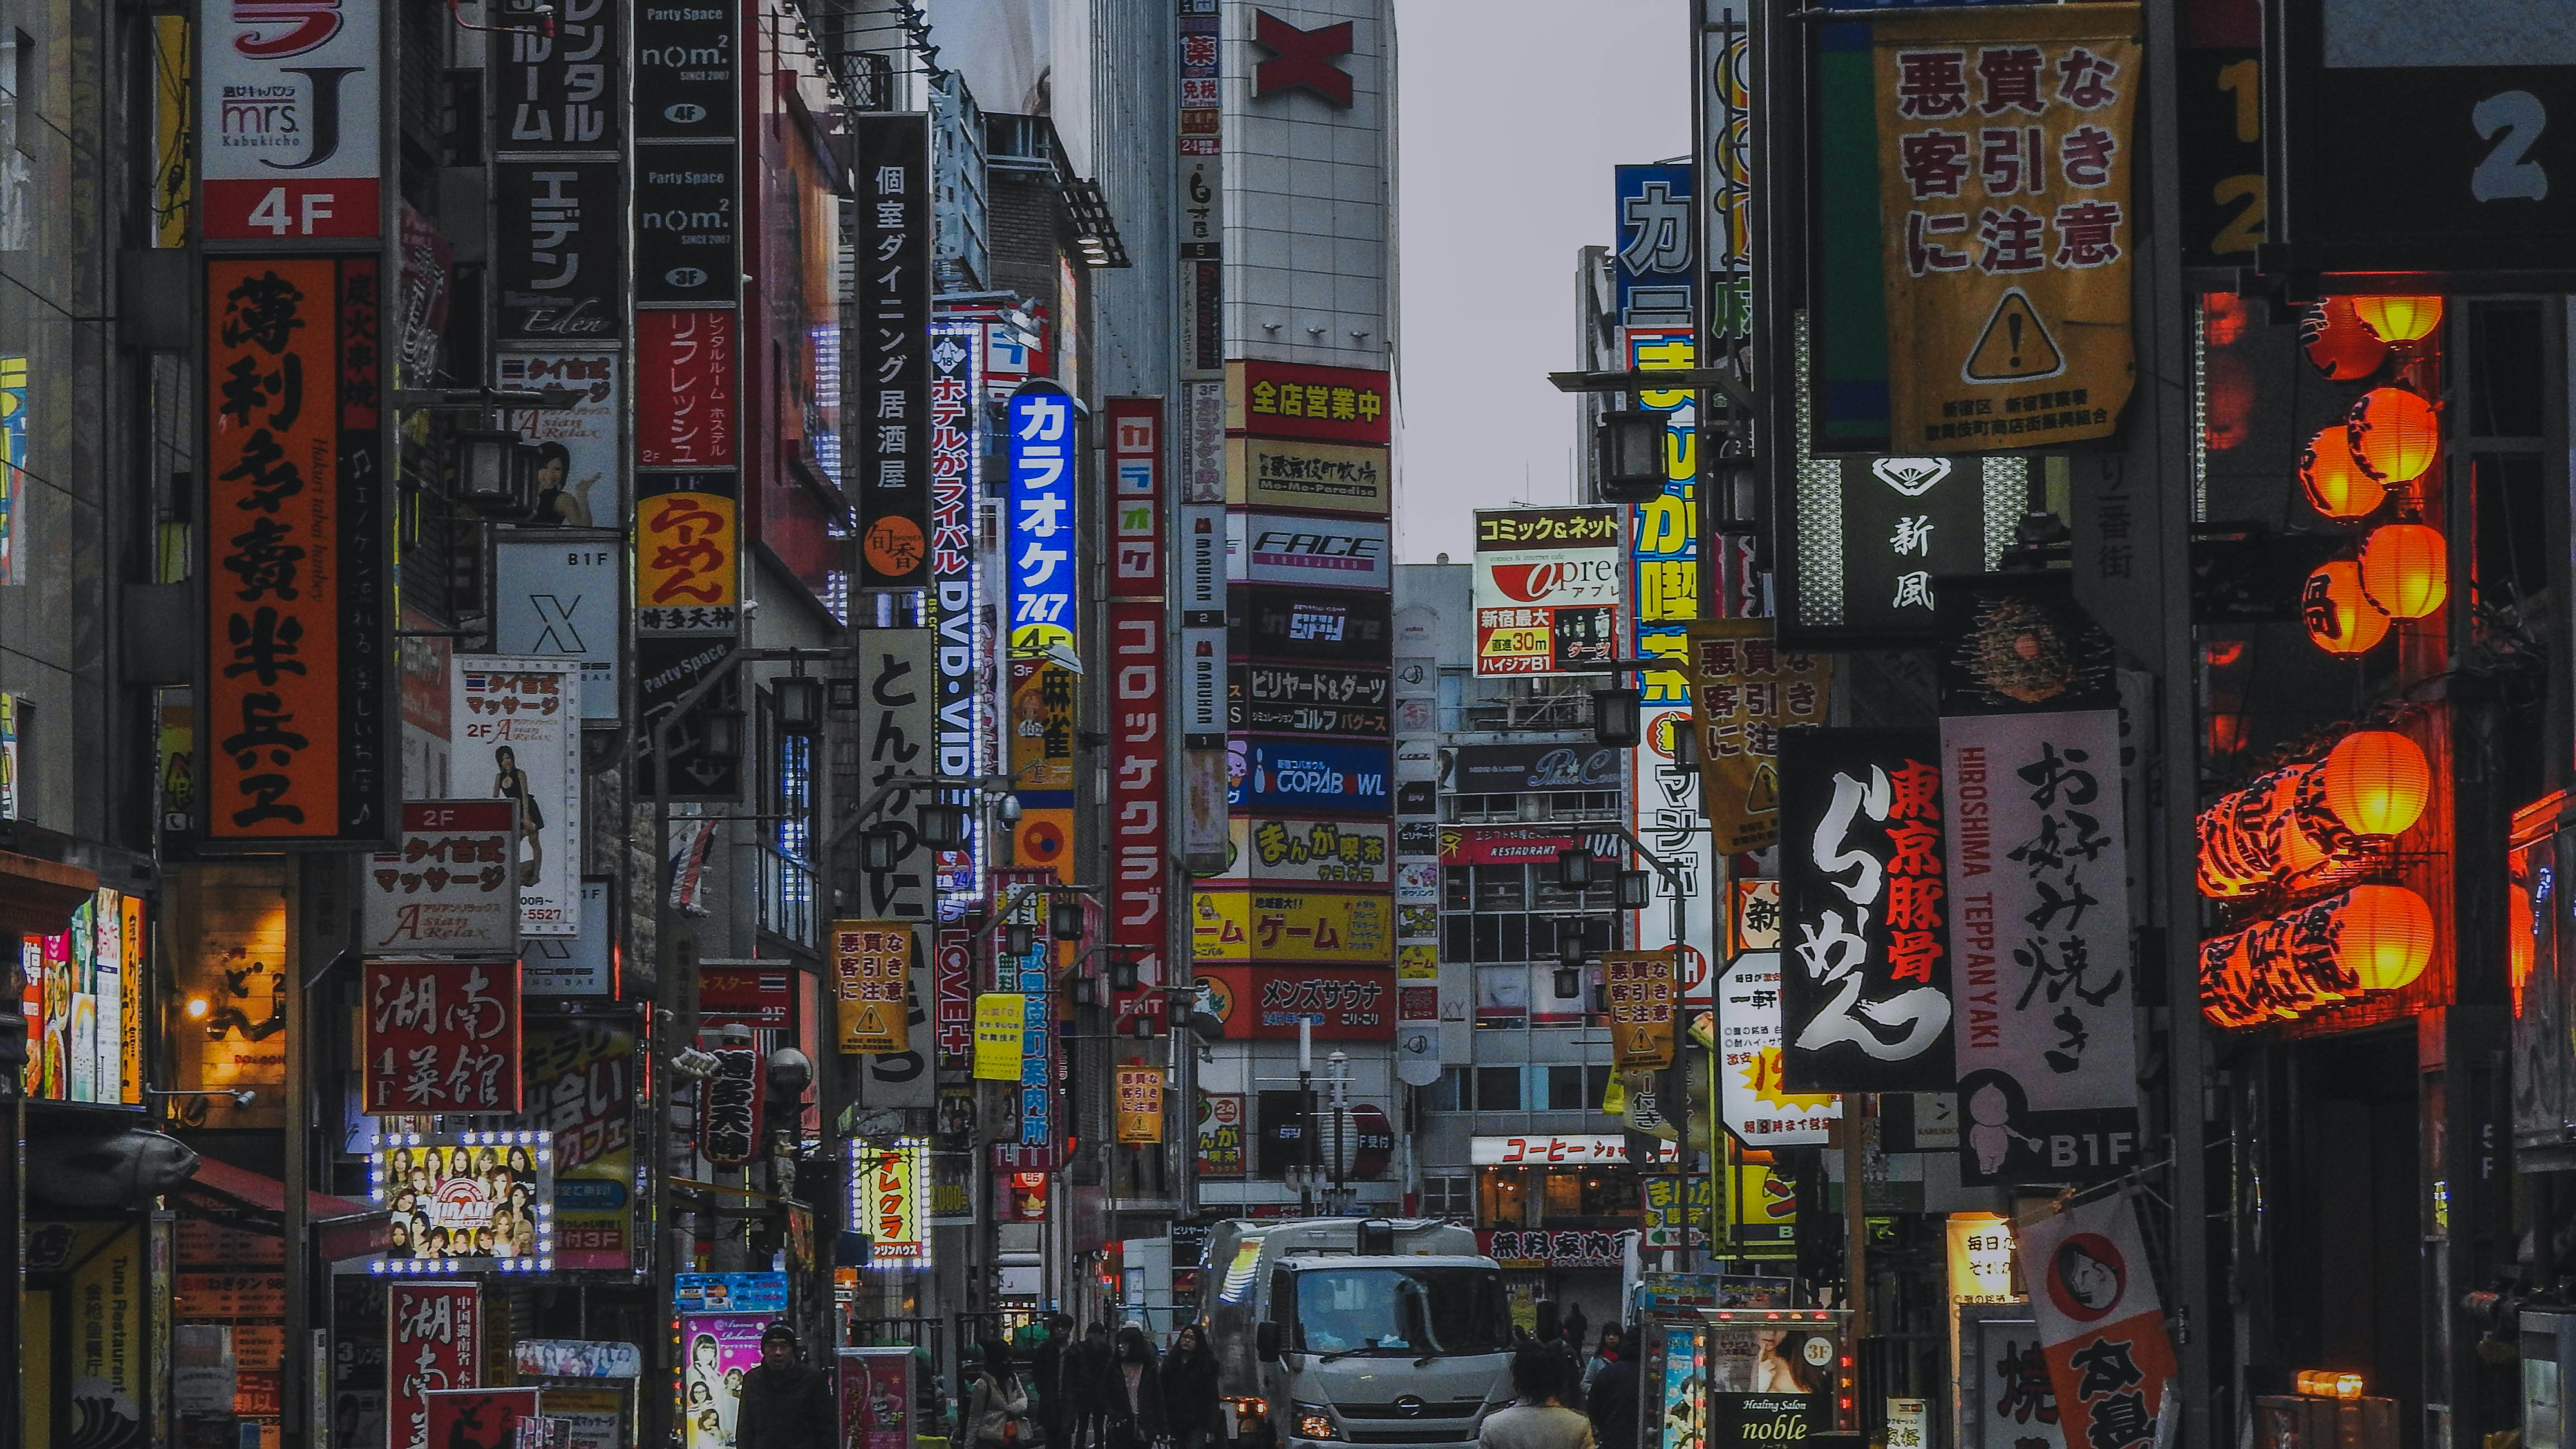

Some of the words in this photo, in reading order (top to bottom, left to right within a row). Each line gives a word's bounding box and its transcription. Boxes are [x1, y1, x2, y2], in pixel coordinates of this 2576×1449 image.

[648, 8, 682, 21] Party
[684, 8, 723, 21] Space
[1183, 80, 1217, 99] 免税
[1897, 45, 2120, 119] 悪質な
[673, 106, 697, 120] 4F
[2218, 59, 2260, 143] 1
[259, 67, 365, 169] J
[222, 135, 300, 146] Kabukicho
[1182, 140, 1198, 151] 24
[2471, 89, 2549, 203] 2
[1901, 124, 2117, 200] 客引き
[648, 171, 683, 184] Party
[685, 171, 725, 184] Space
[248, 187, 335, 235] 4F
[2210, 174, 2269, 255] 2
[531, 171, 581, 290] エデン
[1905, 198, 2123, 277] に注意
[523, 297, 610, 335] Eden
[874, 165, 907, 489] 個室ダイニング居酒屋
[527, 356, 612, 381] タイ古式
[708, 312, 726, 400] レンタルルーム
[670, 312, 698, 463] リフレッシュ
[1252, 380, 1381, 422] 全店営業中
[709, 408, 726, 457] ホステル
[642, 449, 661, 463] 2F
[932, 375, 969, 576] ホテルがライバル
[1261, 480, 1376, 498] Mo-Mo-Paradise
[1017, 396, 1068, 588] カラオケ
[1480, 514, 1619, 542] コミック&ネット
[1253, 531, 1385, 558] FACE
[567, 553, 608, 566] B1F
[1195, 538, 1212, 602] MARUHAN
[1889, 514, 1936, 612] 新風
[641, 607, 736, 629] 博多天神
[1015, 593, 1068, 623] 747
[1199, 613, 1209, 622] 2
[1481, 609, 1550, 628] 新宿最大
[1491, 631, 1547, 652] 直進30m
[1567, 642, 1611, 658] ダーツ
[643, 665, 681, 694] Party
[680, 643, 727, 674] Space
[1014, 665, 1034, 677] 3F
[1481, 655, 1551, 672] ハイジアB1
[487, 673, 560, 696] タイ古式
[1196, 661, 1213, 724] MARUHAN
[1252, 670, 1386, 704] ビリヤード&ダーツ
[466, 696, 560, 716] マッサージ
[1701, 683, 1818, 721] 客引き
[466, 723, 493, 738] 2F
[1293, 708, 1338, 731] ゴルフ
[1342, 714, 1387, 732] バグース
[1201, 736, 1208, 746] 1
[1118, 620, 1162, 926] コロッケクラブ
[423, 809, 454, 827] 2F
[1958, 746, 1992, 878] HIROSHIMA
[405, 835, 506, 863] タイ古式
[1257, 821, 1385, 866] まんが喫茶
[1490, 845, 1556, 857] RESTAURANT
[373, 865, 506, 893] マッサージ
[1884, 757, 1944, 983] 東京豚骨
[2006, 741, 2124, 1074] お好み焼き
[839, 931, 905, 954] 悪質な
[1257, 913, 1342, 951] ゲーム
[840, 956, 905, 979] 客引き
[1401, 957, 1435, 970] ゲーム
[1611, 961, 1671, 981] 悪質な
[373, 965, 506, 1041] 湖南
[840, 982, 905, 1002] に注意
[1261, 978, 1382, 1010] メンズサウナ
[1612, 983, 1671, 1002] 客引き
[1612, 1006, 1671, 1023] に注意
[1020, 941, 1048, 1147] 歌舞伎町案内所
[402, 1044, 505, 1108] 菜館
[1121, 1072, 1158, 1085] 悪質な
[1121, 1087, 1158, 1100] 客引き
[1121, 1100, 1158, 1113] に注意
[1502, 1137, 1585, 1163] コーヒー
[2050, 1131, 2134, 1168] B1F
[878, 1151, 905, 1240] テレクラ
[1807, 1342, 1830, 1361] 3F
[1742, 1399, 1779, 1411] Healing
[1782, 1399, 1807, 1410] Salon
[1741, 1413, 1808, 1442] noble
